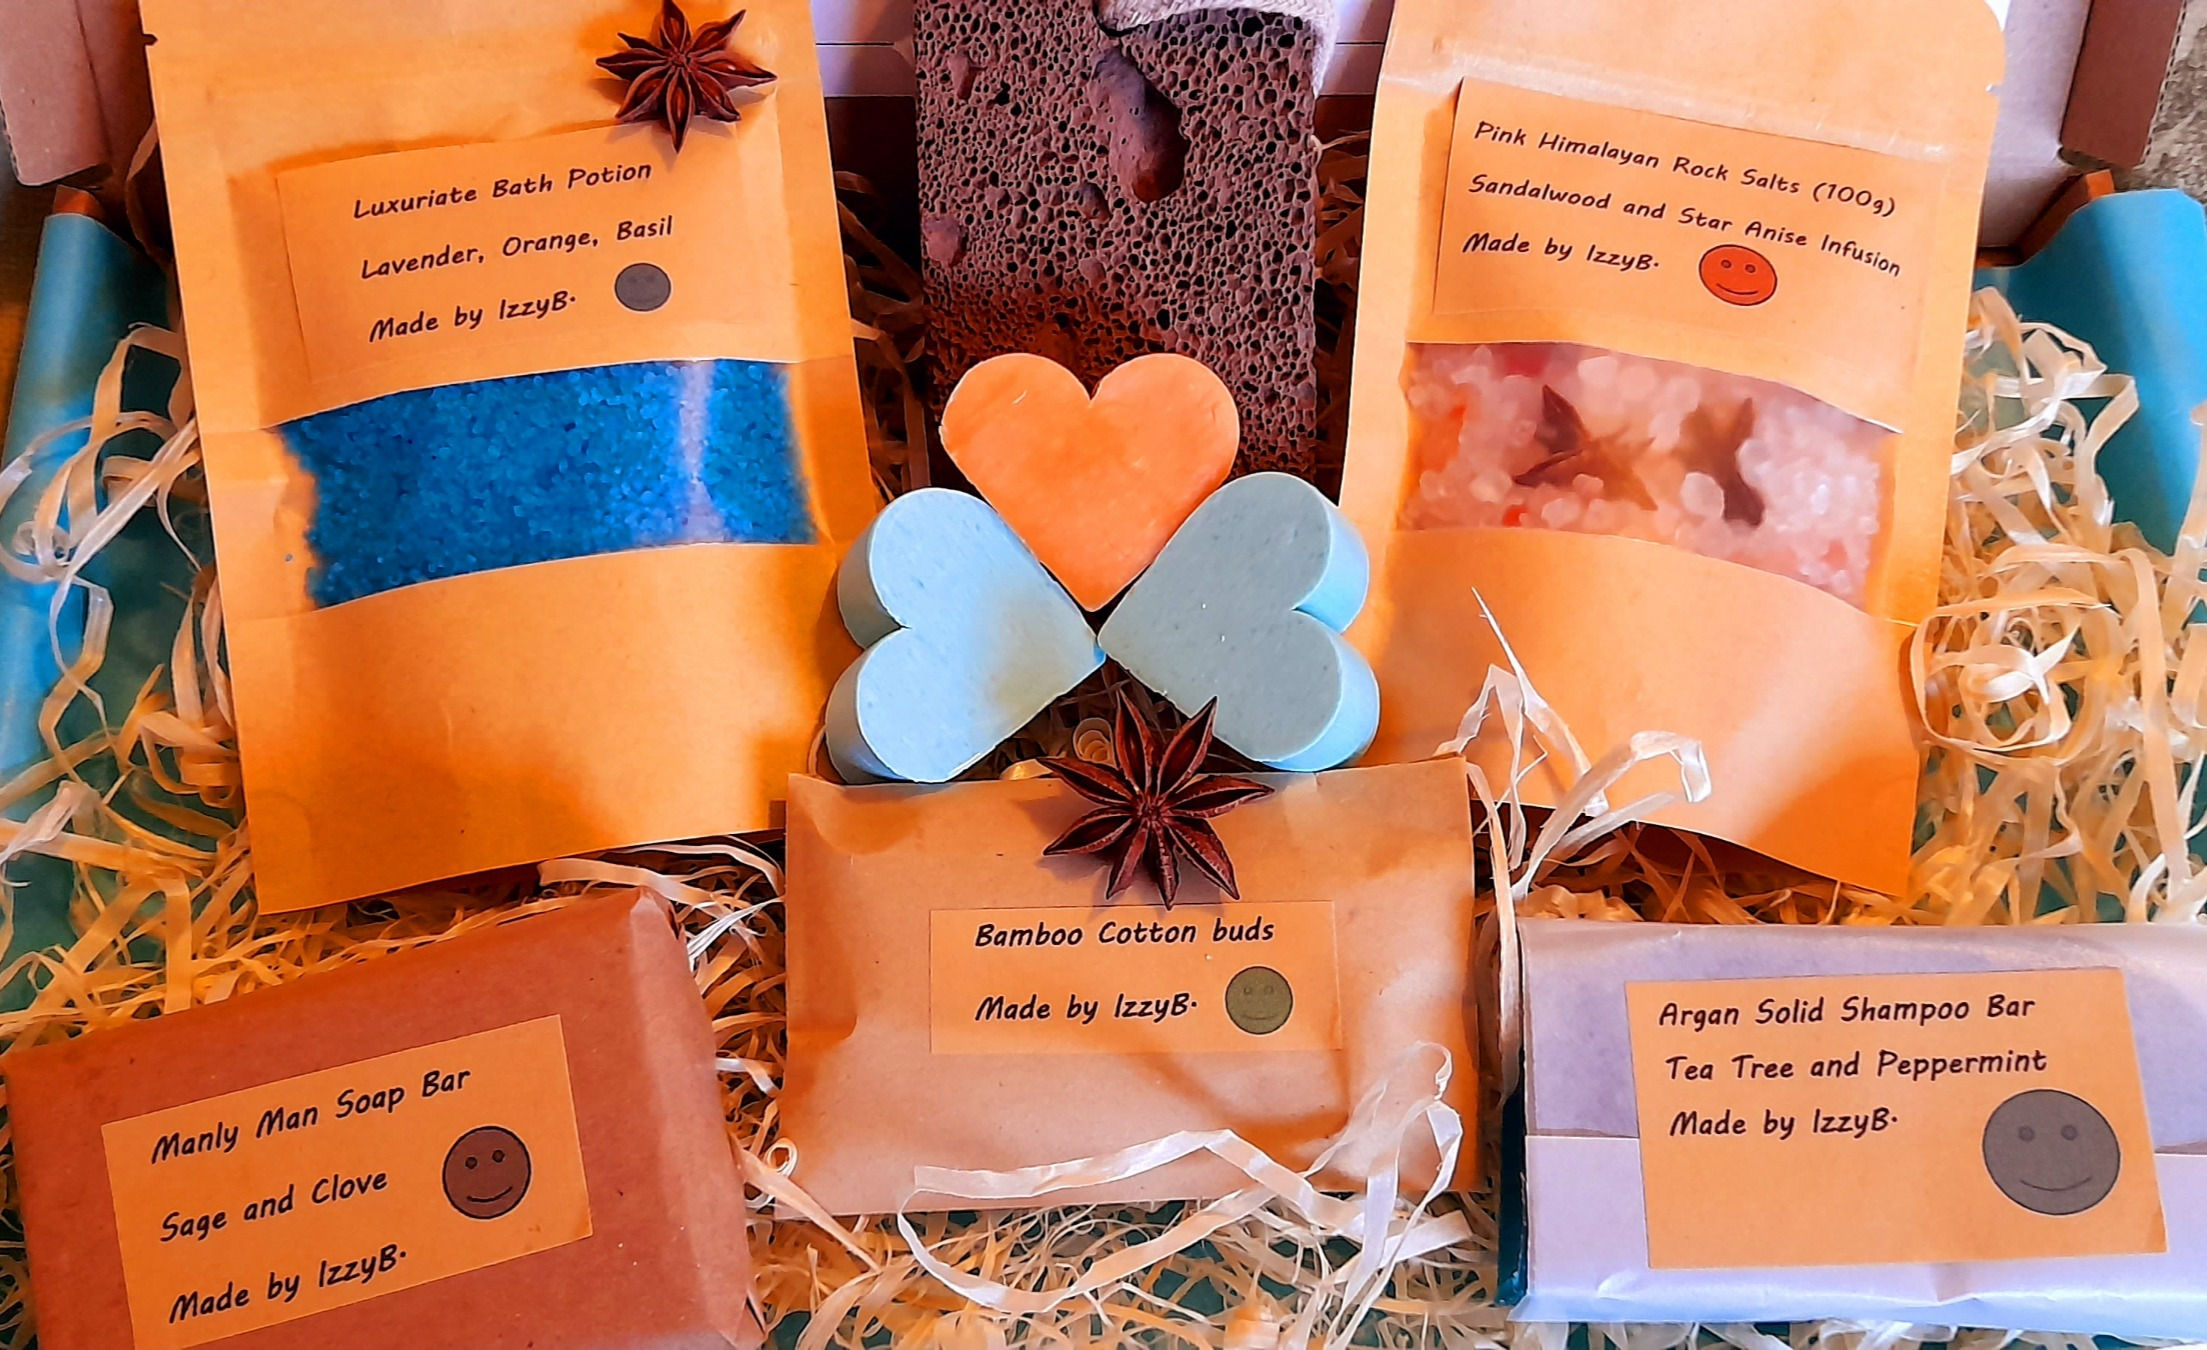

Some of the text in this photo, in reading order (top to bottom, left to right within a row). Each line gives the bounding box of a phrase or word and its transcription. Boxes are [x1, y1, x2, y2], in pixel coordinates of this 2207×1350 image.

[353, 164, 652, 219] Luxuriate Bath Potion
[1473, 120, 1896, 218] Pink Himalayan Rock Salts (100g)
[361, 214, 673, 280] Lavender, Orange, Basil
[1461, 232, 1531, 254] Made
[1543, 236, 1574, 262] by
[1467, 173, 1901, 278] Sandalwood and Star Anise Infusion
[368, 310, 440, 343] Made
[453, 305, 484, 330] by
[974, 915, 1275, 948] Bamboo Cotton buds
[974, 993, 1051, 1022] Made
[1066, 993, 1099, 1025] by
[1658, 993, 2036, 1033] Argan Solid Shampoo Bar
[1664, 1048, 2048, 1082] Tea Tree and Peppermint
[151, 1069, 471, 1165] Manly Man Soap Bar
[1669, 1108, 1747, 1137] Made
[1763, 1108, 1796, 1141] by
[159, 1172, 388, 1242] Sage and Clove
[168, 1280, 250, 1324] Made
[267, 1271, 301, 1303] by
